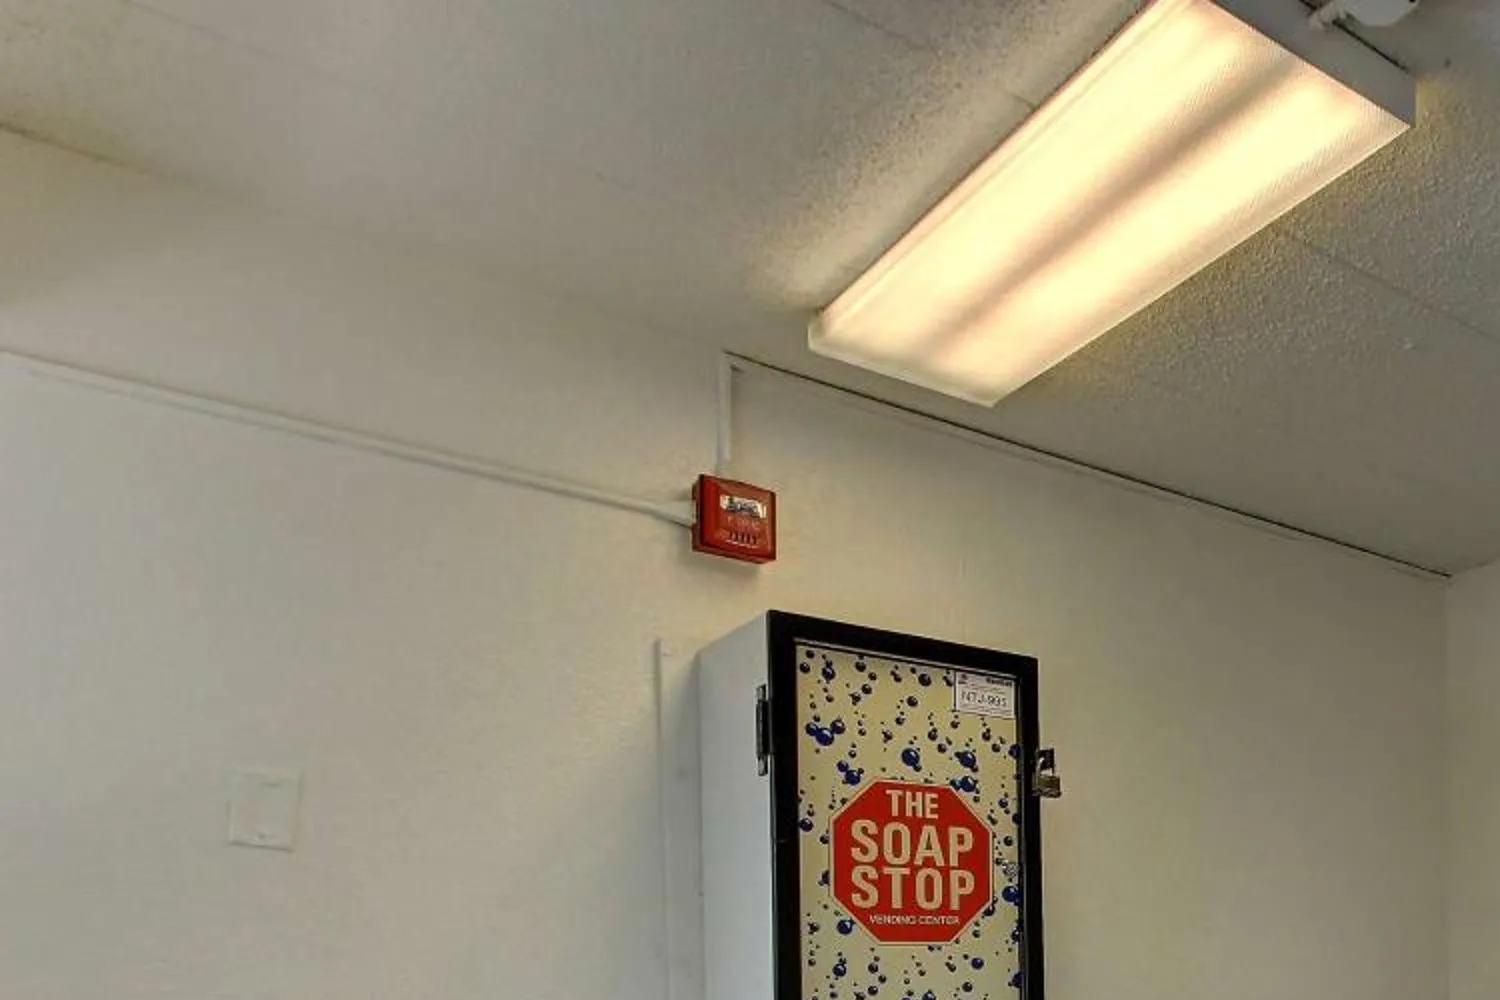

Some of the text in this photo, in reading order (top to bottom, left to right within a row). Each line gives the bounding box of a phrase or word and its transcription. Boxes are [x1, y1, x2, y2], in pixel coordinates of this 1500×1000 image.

[885, 789, 939, 820] THE
[851, 818, 974, 868] SOAP
[851, 864, 975, 911] STOP
[869, 914, 960, 926] VENDING CENTER
